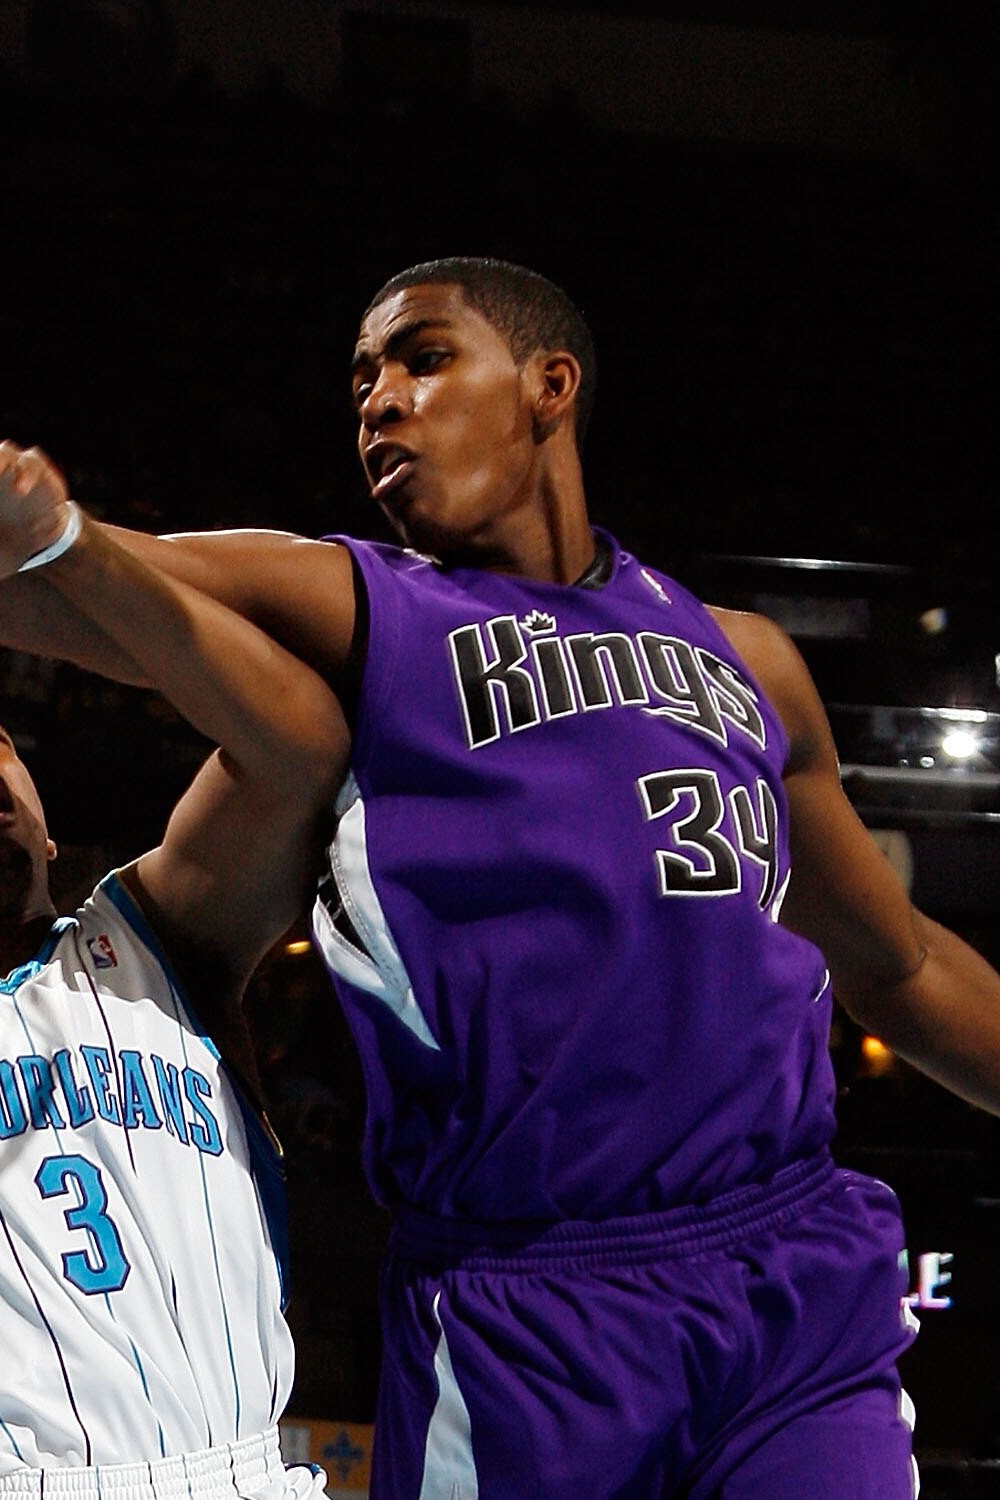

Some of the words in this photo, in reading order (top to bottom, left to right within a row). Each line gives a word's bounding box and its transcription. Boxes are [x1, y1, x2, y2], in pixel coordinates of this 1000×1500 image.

[447, 609, 767, 752] Kings
[636, 769, 779, 912] 34
[34, 1153, 131, 1296] 3
